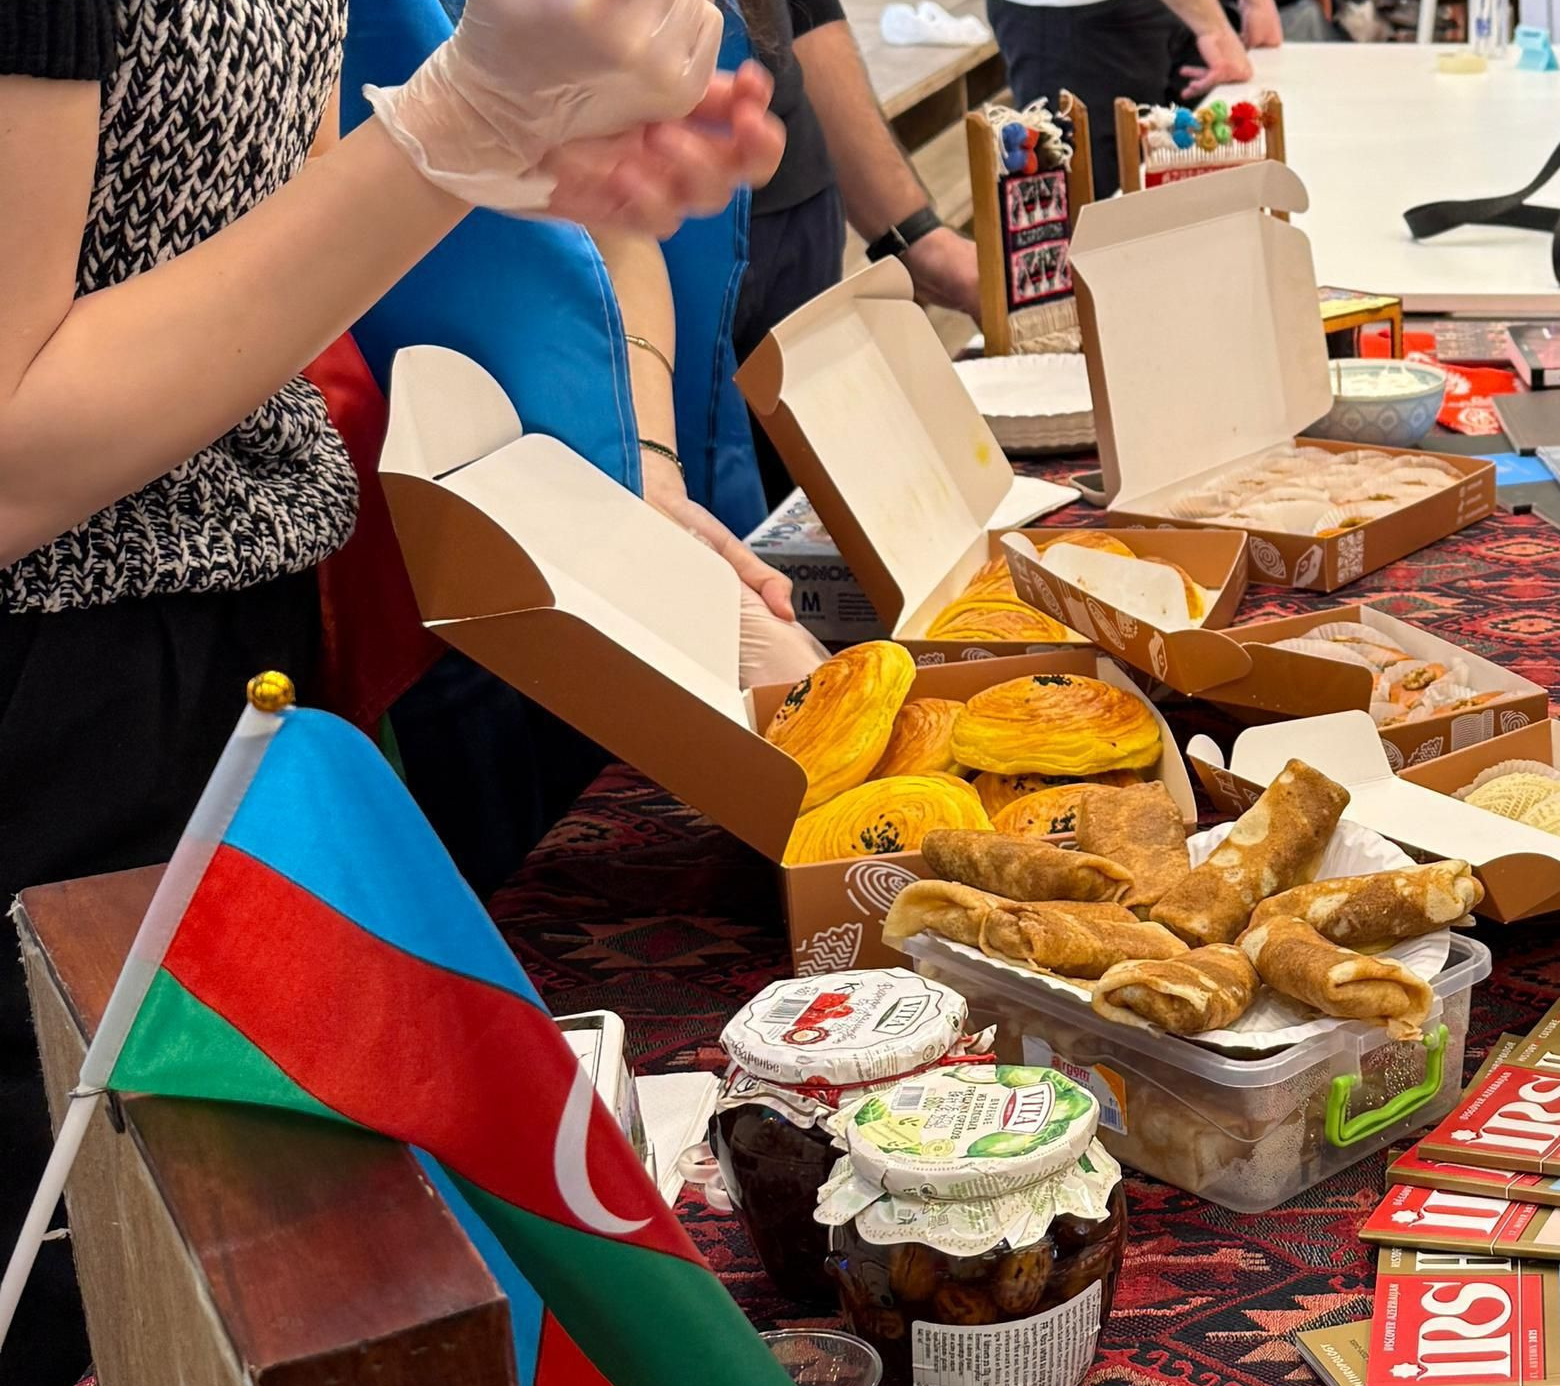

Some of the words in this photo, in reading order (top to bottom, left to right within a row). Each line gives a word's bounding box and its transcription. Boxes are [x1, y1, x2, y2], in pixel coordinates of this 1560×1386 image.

[1517, 1043, 1538, 1063] HISTORY
[1012, 1089, 1045, 1127] VITA
[1390, 1281, 1513, 1382] IRS
